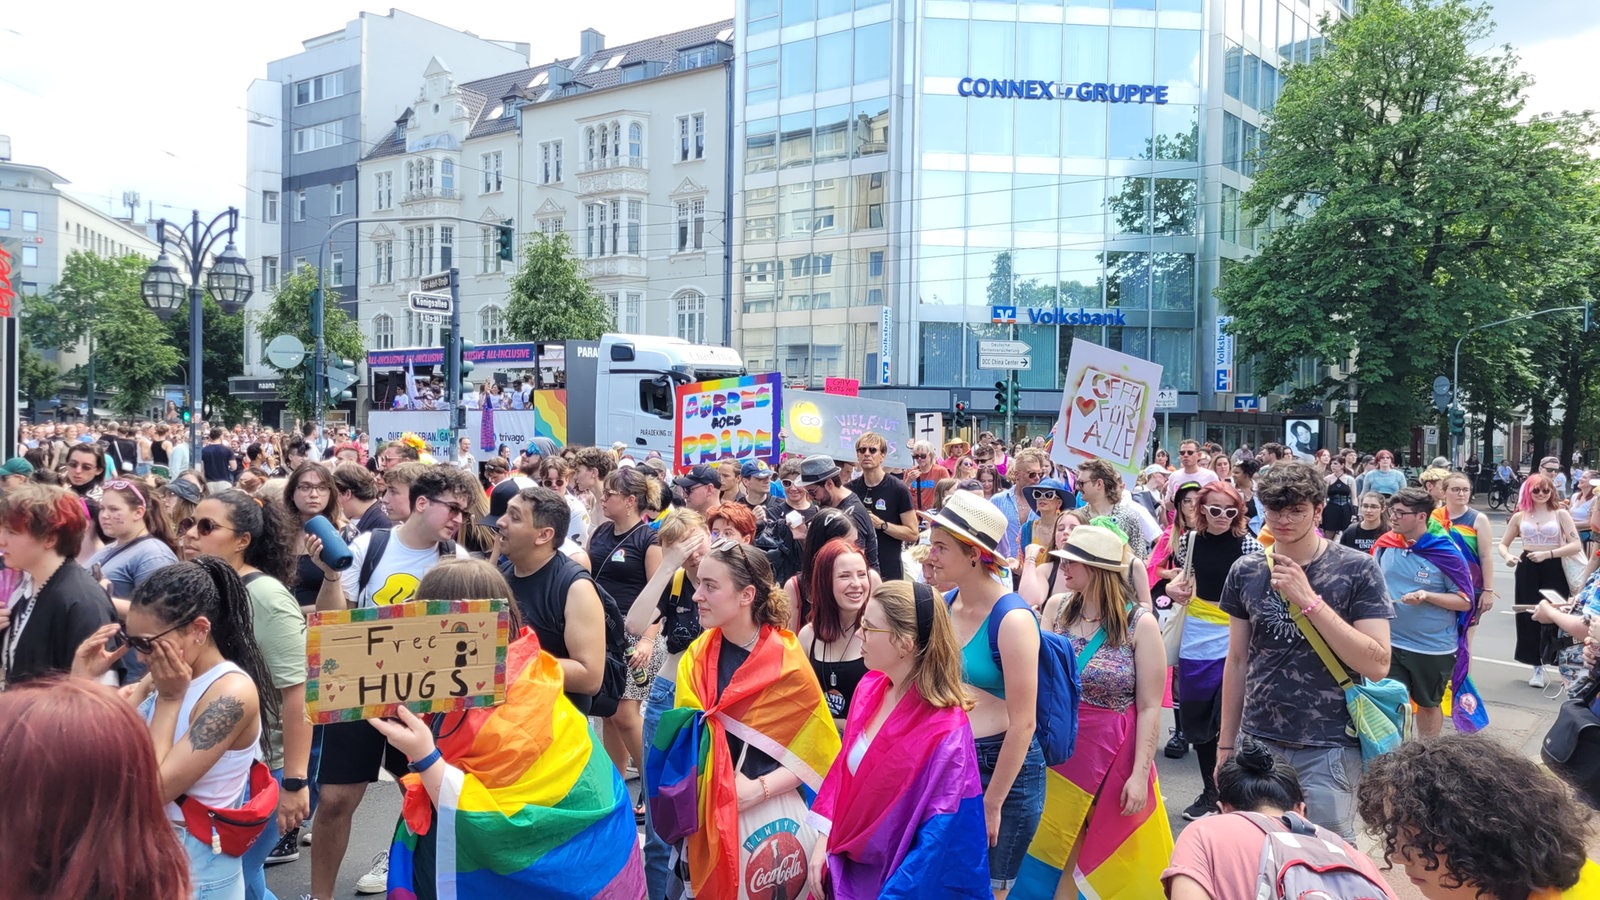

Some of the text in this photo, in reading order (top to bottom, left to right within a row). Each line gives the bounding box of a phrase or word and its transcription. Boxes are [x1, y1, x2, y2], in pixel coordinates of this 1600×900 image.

[957, 77, 1169, 105] CONNEX GRUPPE
[1028, 307, 1126, 326] Volksbank
[368, 354, 405, 364] ALL-INCLUSIVE
[487, 349, 530, 359] ALL-INCLUSIVE
[577, 346, 600, 358] PARA
[992, 358, 1004, 366] China
[1098, 399, 1136, 429] FÜR
[499, 432, 525, 445] trivago
[1082, 420, 1136, 459] ALLE
[367, 625, 438, 656] Free
[358, 669, 469, 706] HUGS
[746, 820, 798, 850] ALWAYS
